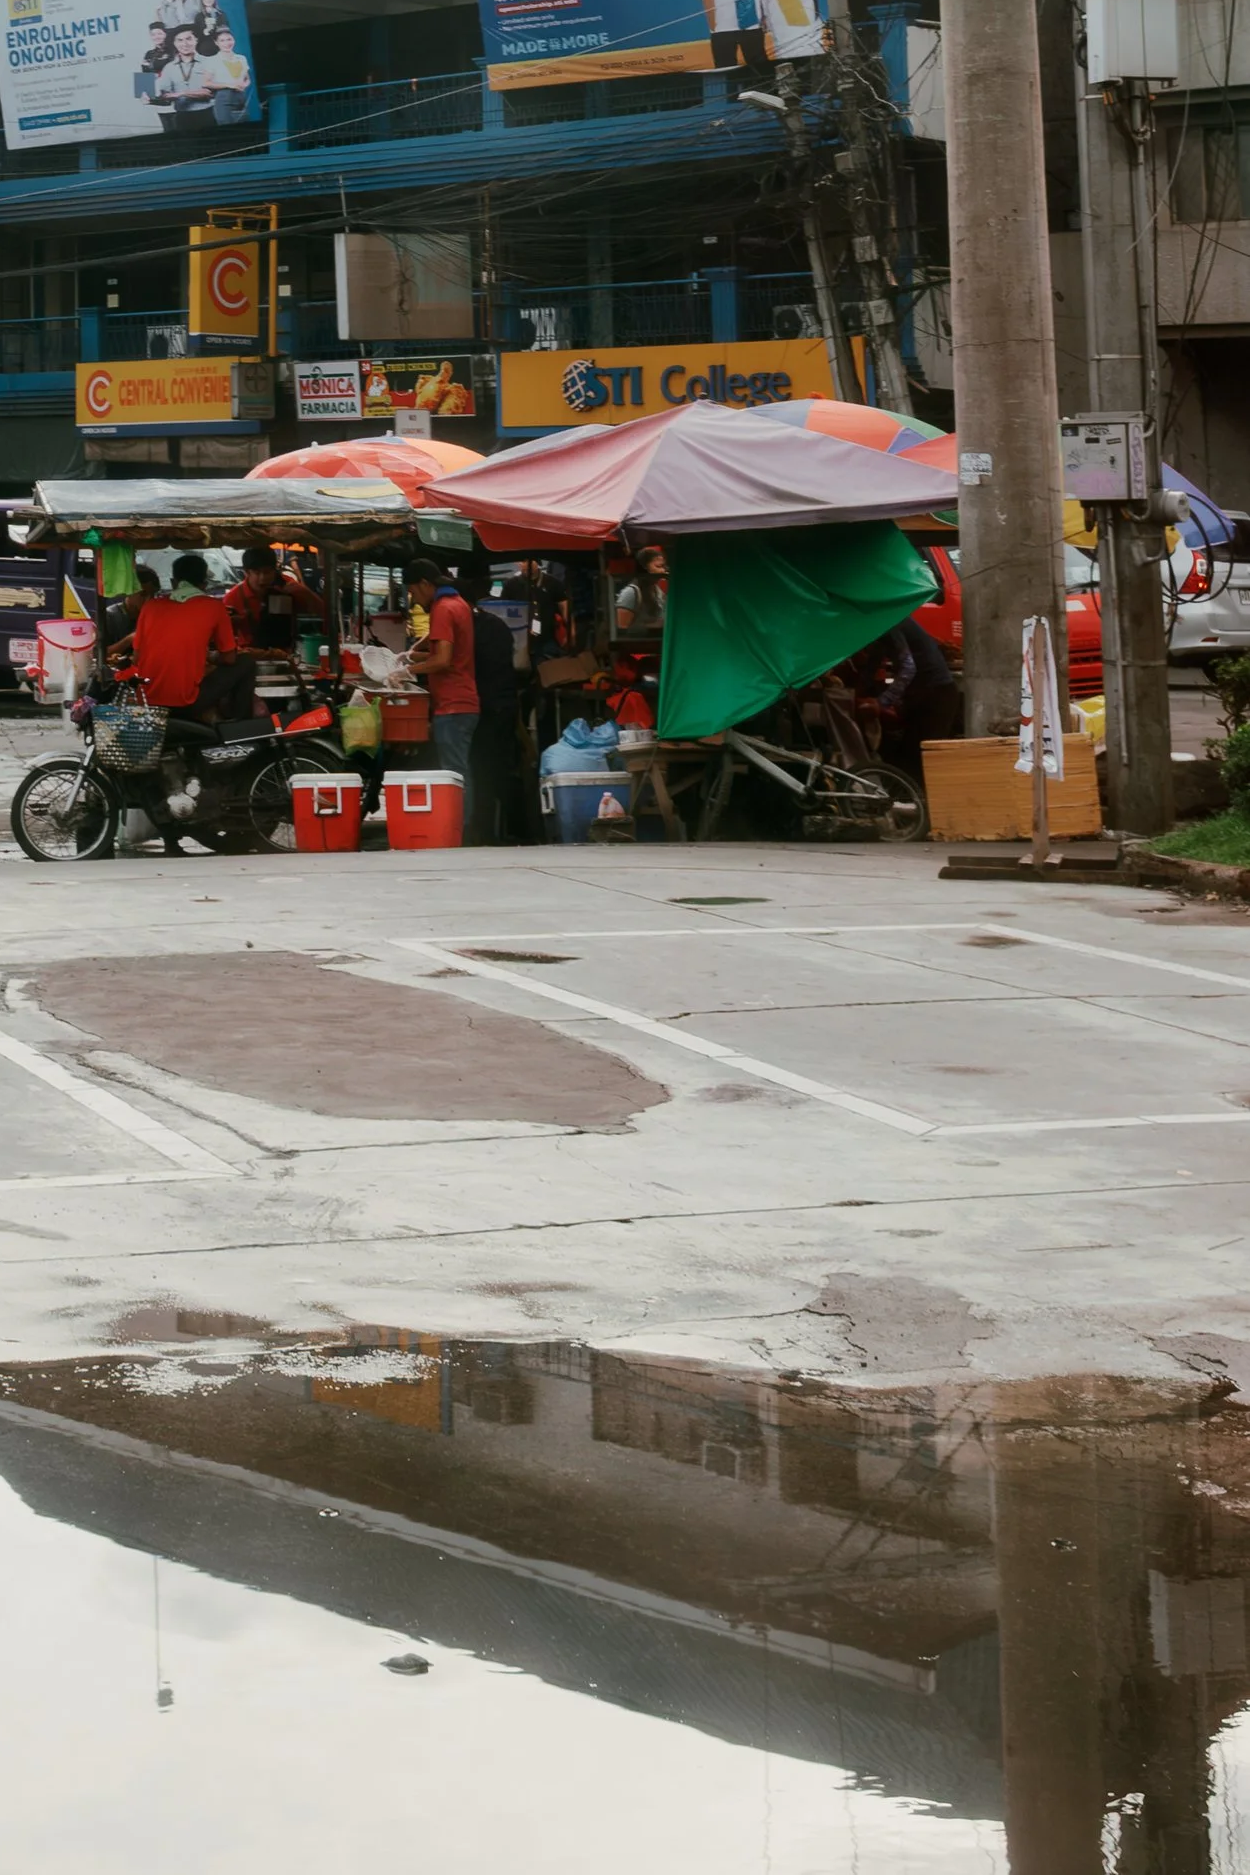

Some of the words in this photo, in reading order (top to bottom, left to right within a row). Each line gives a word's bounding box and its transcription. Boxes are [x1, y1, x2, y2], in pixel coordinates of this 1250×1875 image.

[6, 15, 121, 49] ENROLLMENT
[561, 32, 609, 50] MORE
[9, 40, 87, 67] ONGOING
[502, 40, 547, 56] MADE
[118, 378, 168, 406] CENTRAL
[170, 375, 231, 405] CONVENIE
[299, 377, 356, 395] MONICA
[588, 366, 644, 407] STI
[661, 364, 792, 408] College
[301, 401, 357, 415] FARMACIA
